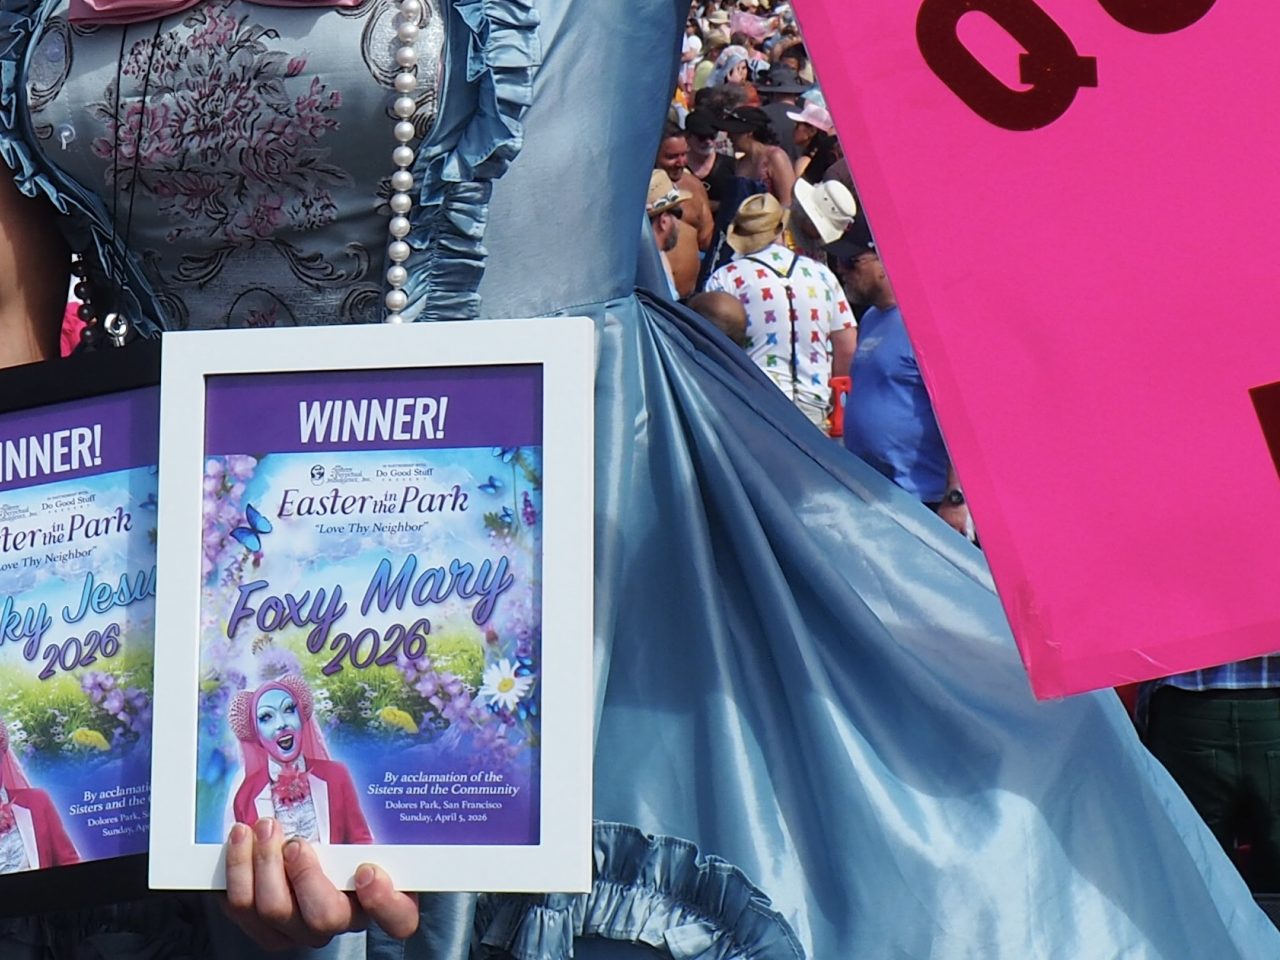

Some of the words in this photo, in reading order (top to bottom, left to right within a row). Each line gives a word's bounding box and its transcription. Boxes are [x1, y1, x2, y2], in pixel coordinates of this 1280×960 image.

[299, 396, 448, 443] WINNER!
[376, 469, 388, 477] Do
[390, 468, 412, 477] Good
[414, 467, 434, 476] Stuff
[41, 502, 53, 510] Do
[55, 497, 76, 508] Good
[77, 493, 96, 504] Stuff
[277, 488, 373, 519] Easter
[384, 490, 397, 502] in
[398, 484, 469, 514] Park
[373, 499, 396, 514] the
[52, 522, 64, 533] in
[67, 506, 133, 542] Park
[348, 523, 370, 536] Thy
[42, 531, 65, 546] the
[21, 556, 42, 569] Thy
[62, 565, 156, 624] Jesu
[227, 579, 347, 654] Foxy
[360, 553, 514, 626] Mary
[38, 623, 120, 680] 2026
[321, 618, 431, 676] 2026
[384, 772, 399, 785] By
[400, 772, 467, 783] acclamation
[470, 771, 484, 783] of
[484, 771, 503, 783] the
[84, 790, 97, 803] By
[99, 782, 152, 799] acclamati
[367, 783, 403, 795] Sisters
[406, 783, 427, 795] and
[430, 784, 448, 795] the
[451, 783, 520, 797] Community
[69, 803, 103, 815] Sisters
[105, 797, 126, 810] and
[128, 795, 145, 806] the
[385, 800, 417, 809] Dolores
[420, 800, 441, 810] Park,
[443, 800, 459, 809] San
[461, 800, 502, 809] Francisco
[87, 817, 118, 827] Dolores
[400, 813, 433, 823] Sunday,
[435, 813, 457, 823] April
[459, 814, 466, 823] 5,
[468, 813, 487, 822] 2026
